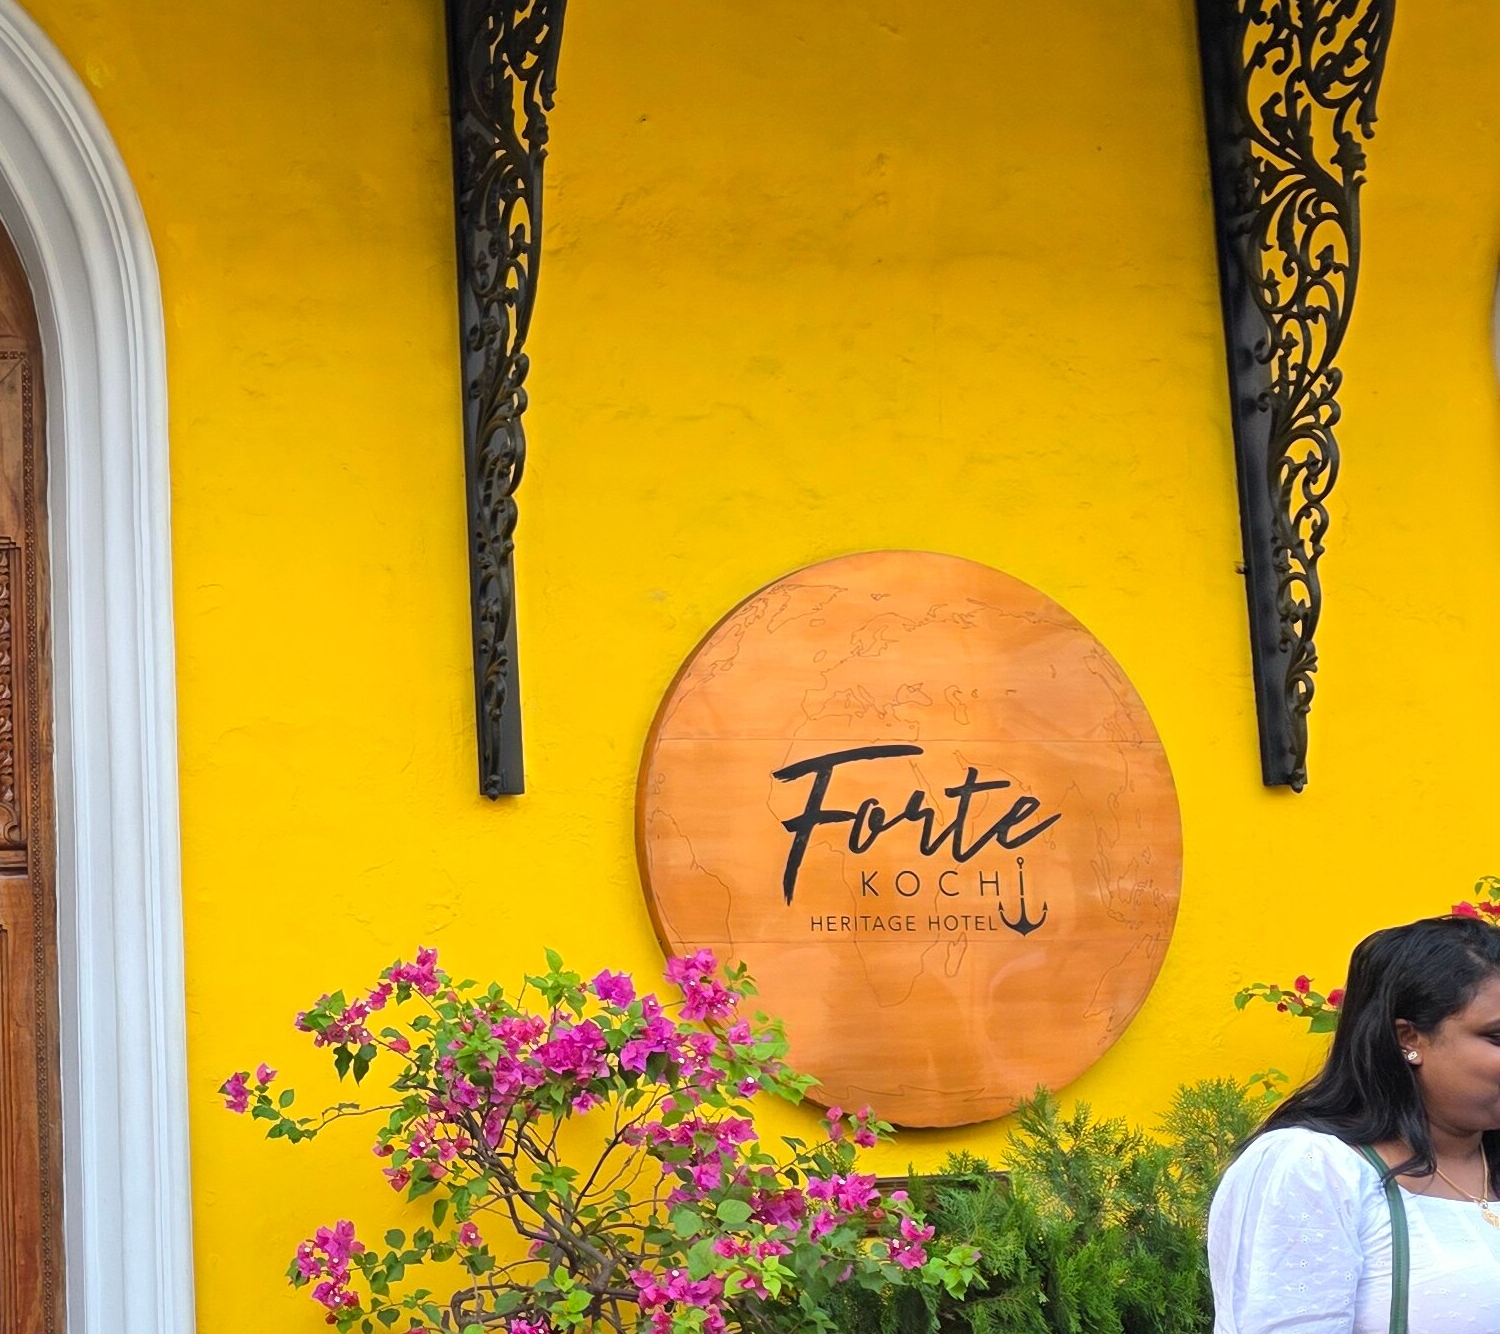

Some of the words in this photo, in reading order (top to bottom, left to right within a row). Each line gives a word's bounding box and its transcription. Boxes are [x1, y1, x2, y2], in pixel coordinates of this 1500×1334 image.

[772, 744, 1062, 907] Forte
[810, 915, 917, 933] HERITAGE
[928, 915, 999, 932] HOTEL
